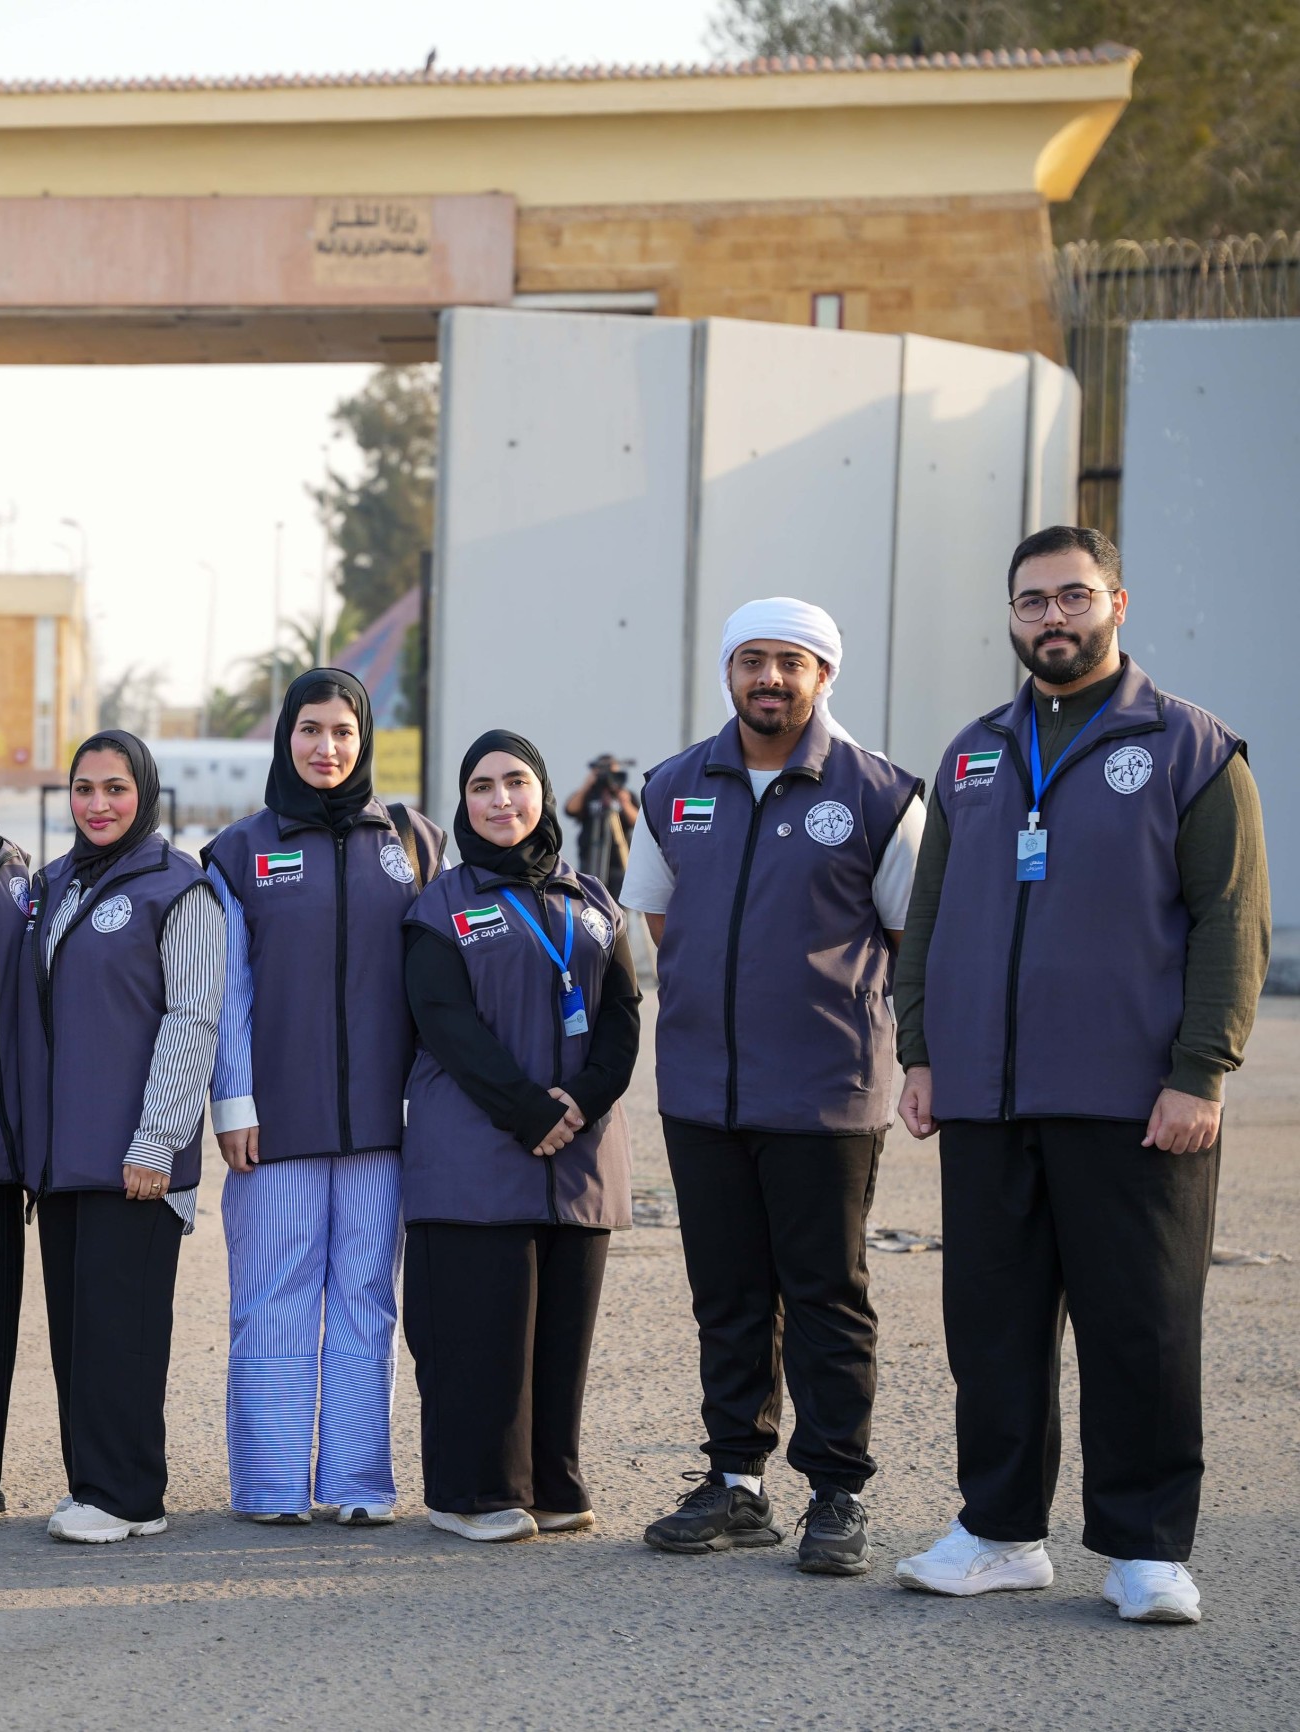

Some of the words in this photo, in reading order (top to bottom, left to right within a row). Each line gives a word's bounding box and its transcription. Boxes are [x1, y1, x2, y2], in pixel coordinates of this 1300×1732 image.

[954, 780, 967, 792] UAE
[671, 824, 683, 833] UAE
[256, 878, 273, 888] UAE
[275, 872, 303, 883] الإمارات
[480, 924, 508, 938] الإمارات
[460, 933, 479, 947] UAE
